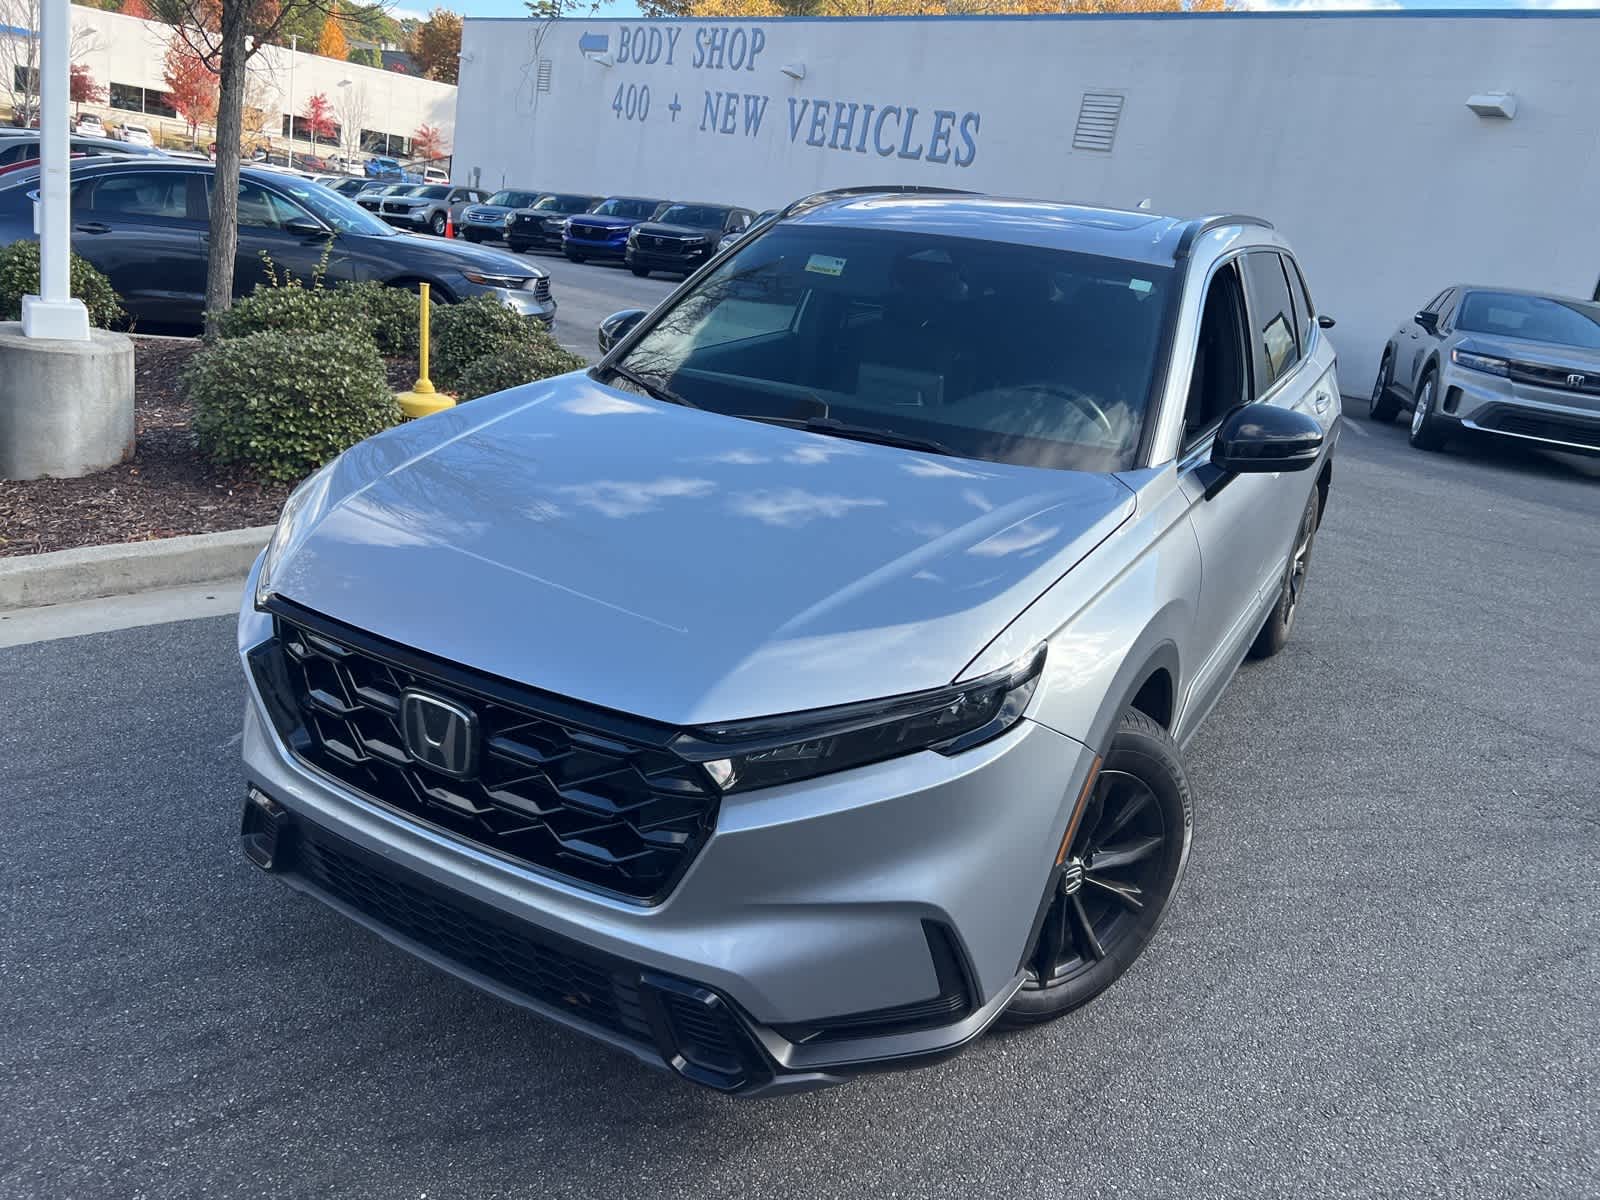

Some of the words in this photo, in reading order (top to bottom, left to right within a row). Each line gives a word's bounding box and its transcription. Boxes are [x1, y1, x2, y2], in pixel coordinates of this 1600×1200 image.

[616, 26, 681, 65] BODY
[692, 26, 766, 71] SHOP
[612, 82, 650, 122] 400
[700, 90, 769, 137] NEW
[787, 97, 981, 167] VEHICLES
